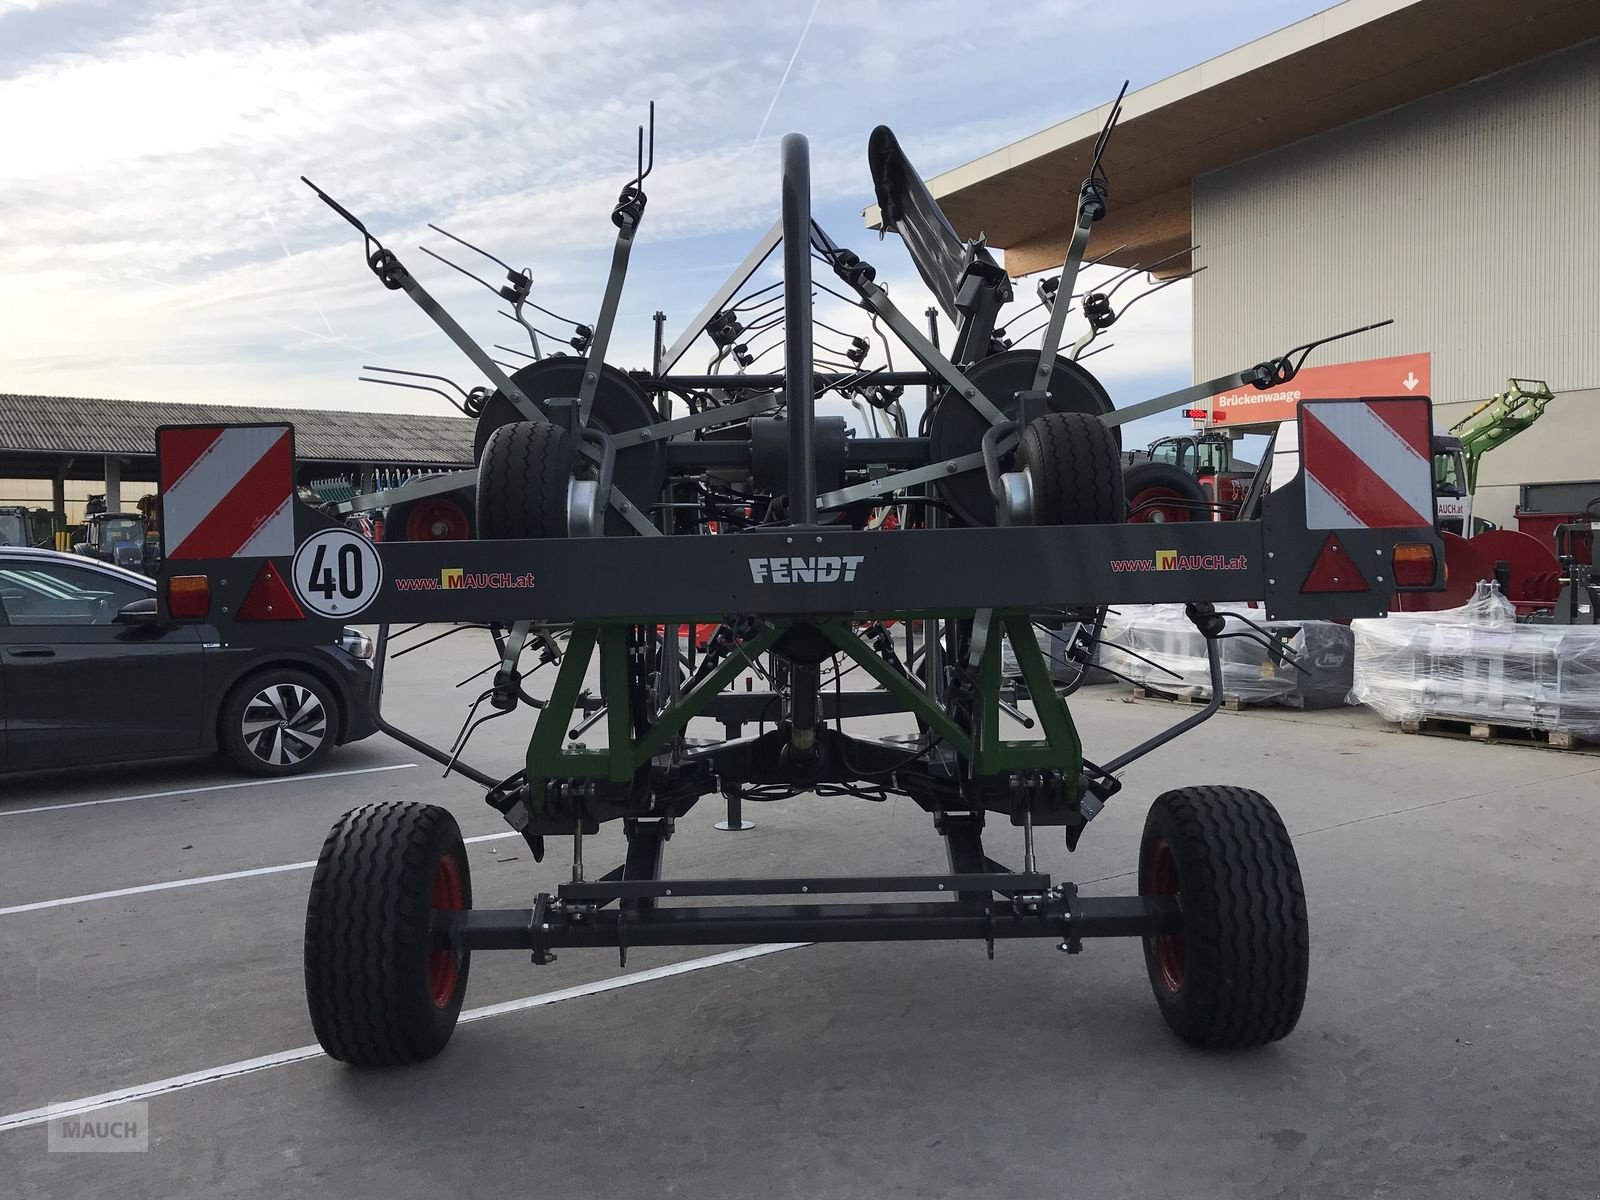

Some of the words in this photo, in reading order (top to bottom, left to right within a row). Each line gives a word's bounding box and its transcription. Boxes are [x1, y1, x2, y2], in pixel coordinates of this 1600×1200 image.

[1219, 390, 1301, 407] Brückenwaage
[1438, 504, 1463, 514] AUCH.at
[308, 544, 363, 599] 40
[748, 556, 865, 584] FENDT
[1110, 554, 1248, 572] www.MAUCH.at
[395, 572, 535, 590] www.MAUCH.at
